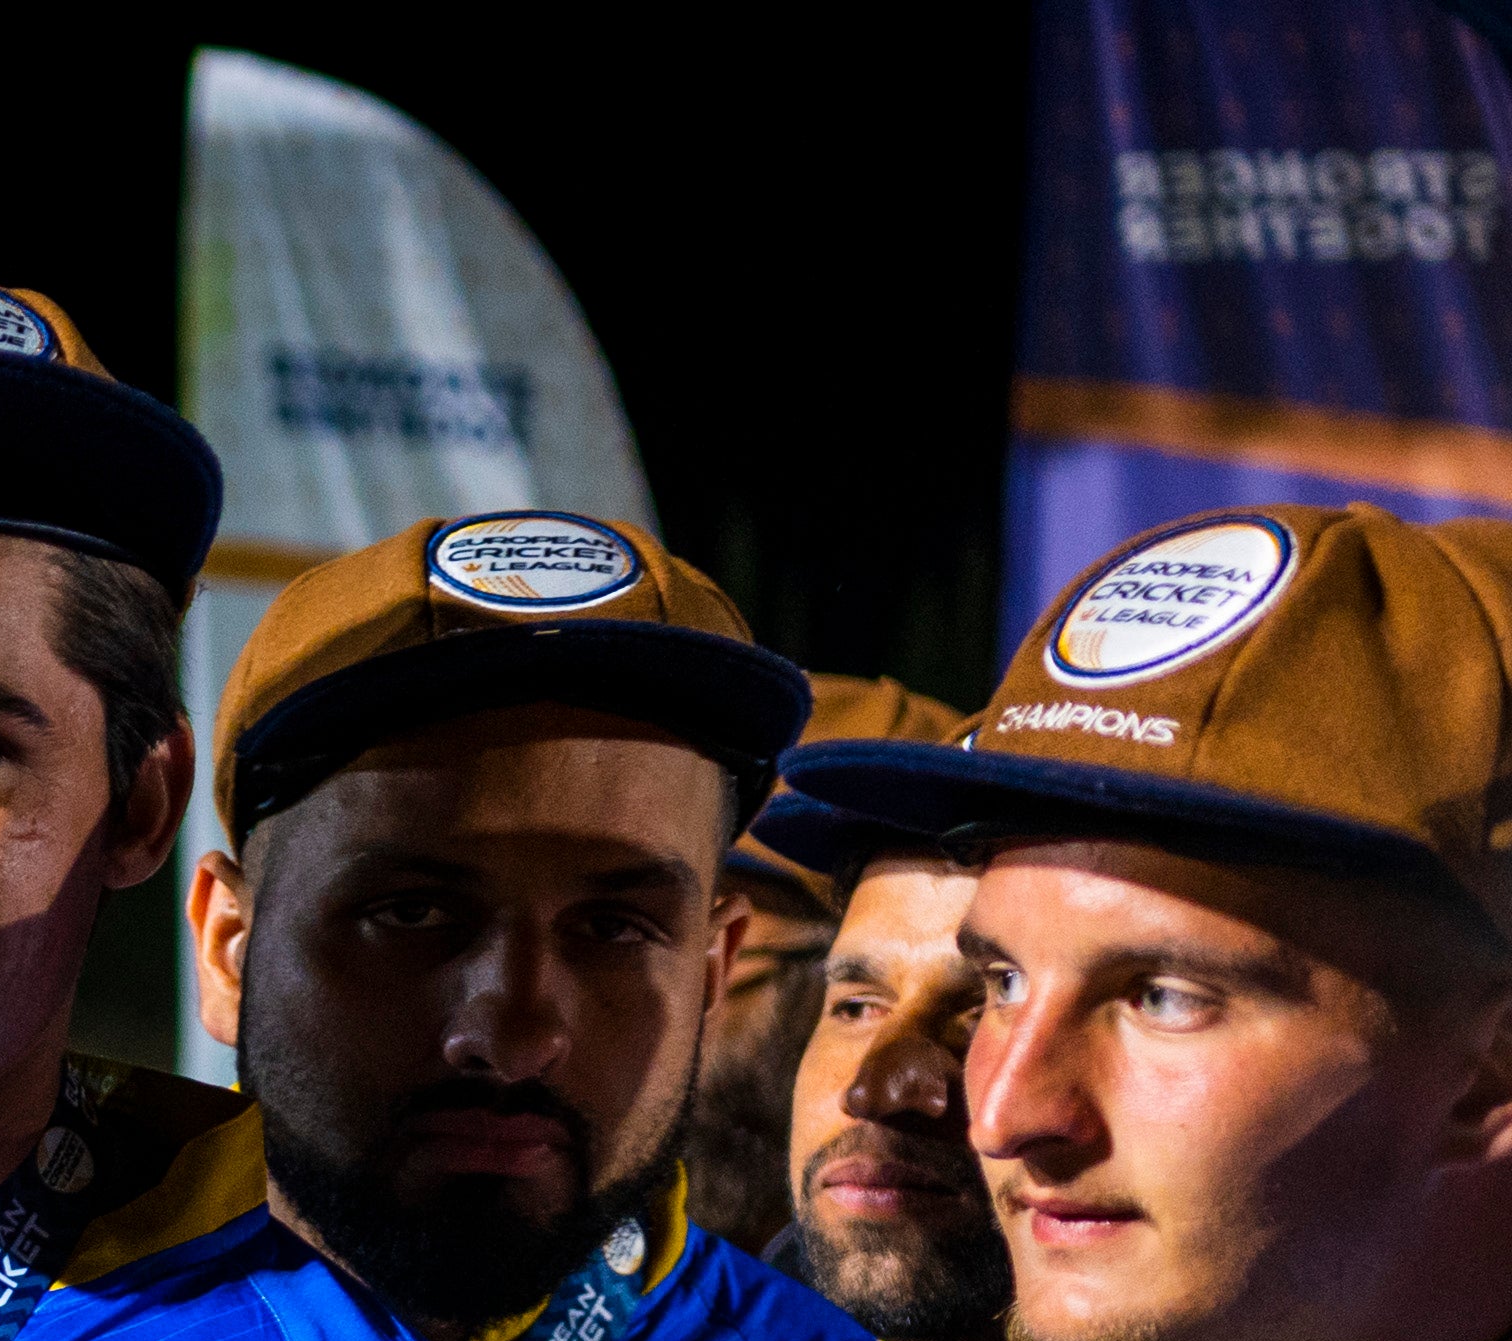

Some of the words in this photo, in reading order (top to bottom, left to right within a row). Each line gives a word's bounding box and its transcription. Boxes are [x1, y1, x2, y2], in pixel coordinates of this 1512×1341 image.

[449, 535, 614, 549] EUROPEAN
[448, 547, 621, 562] CRICKET
[490, 561, 614, 574] LEAGUE
[1114, 561, 1254, 583] EUROPEAN
[1090, 581, 1248, 606] CRICKET
[1094, 608, 1208, 629] LEAGUE
[996, 702, 1181, 747] CHAMPIONS
